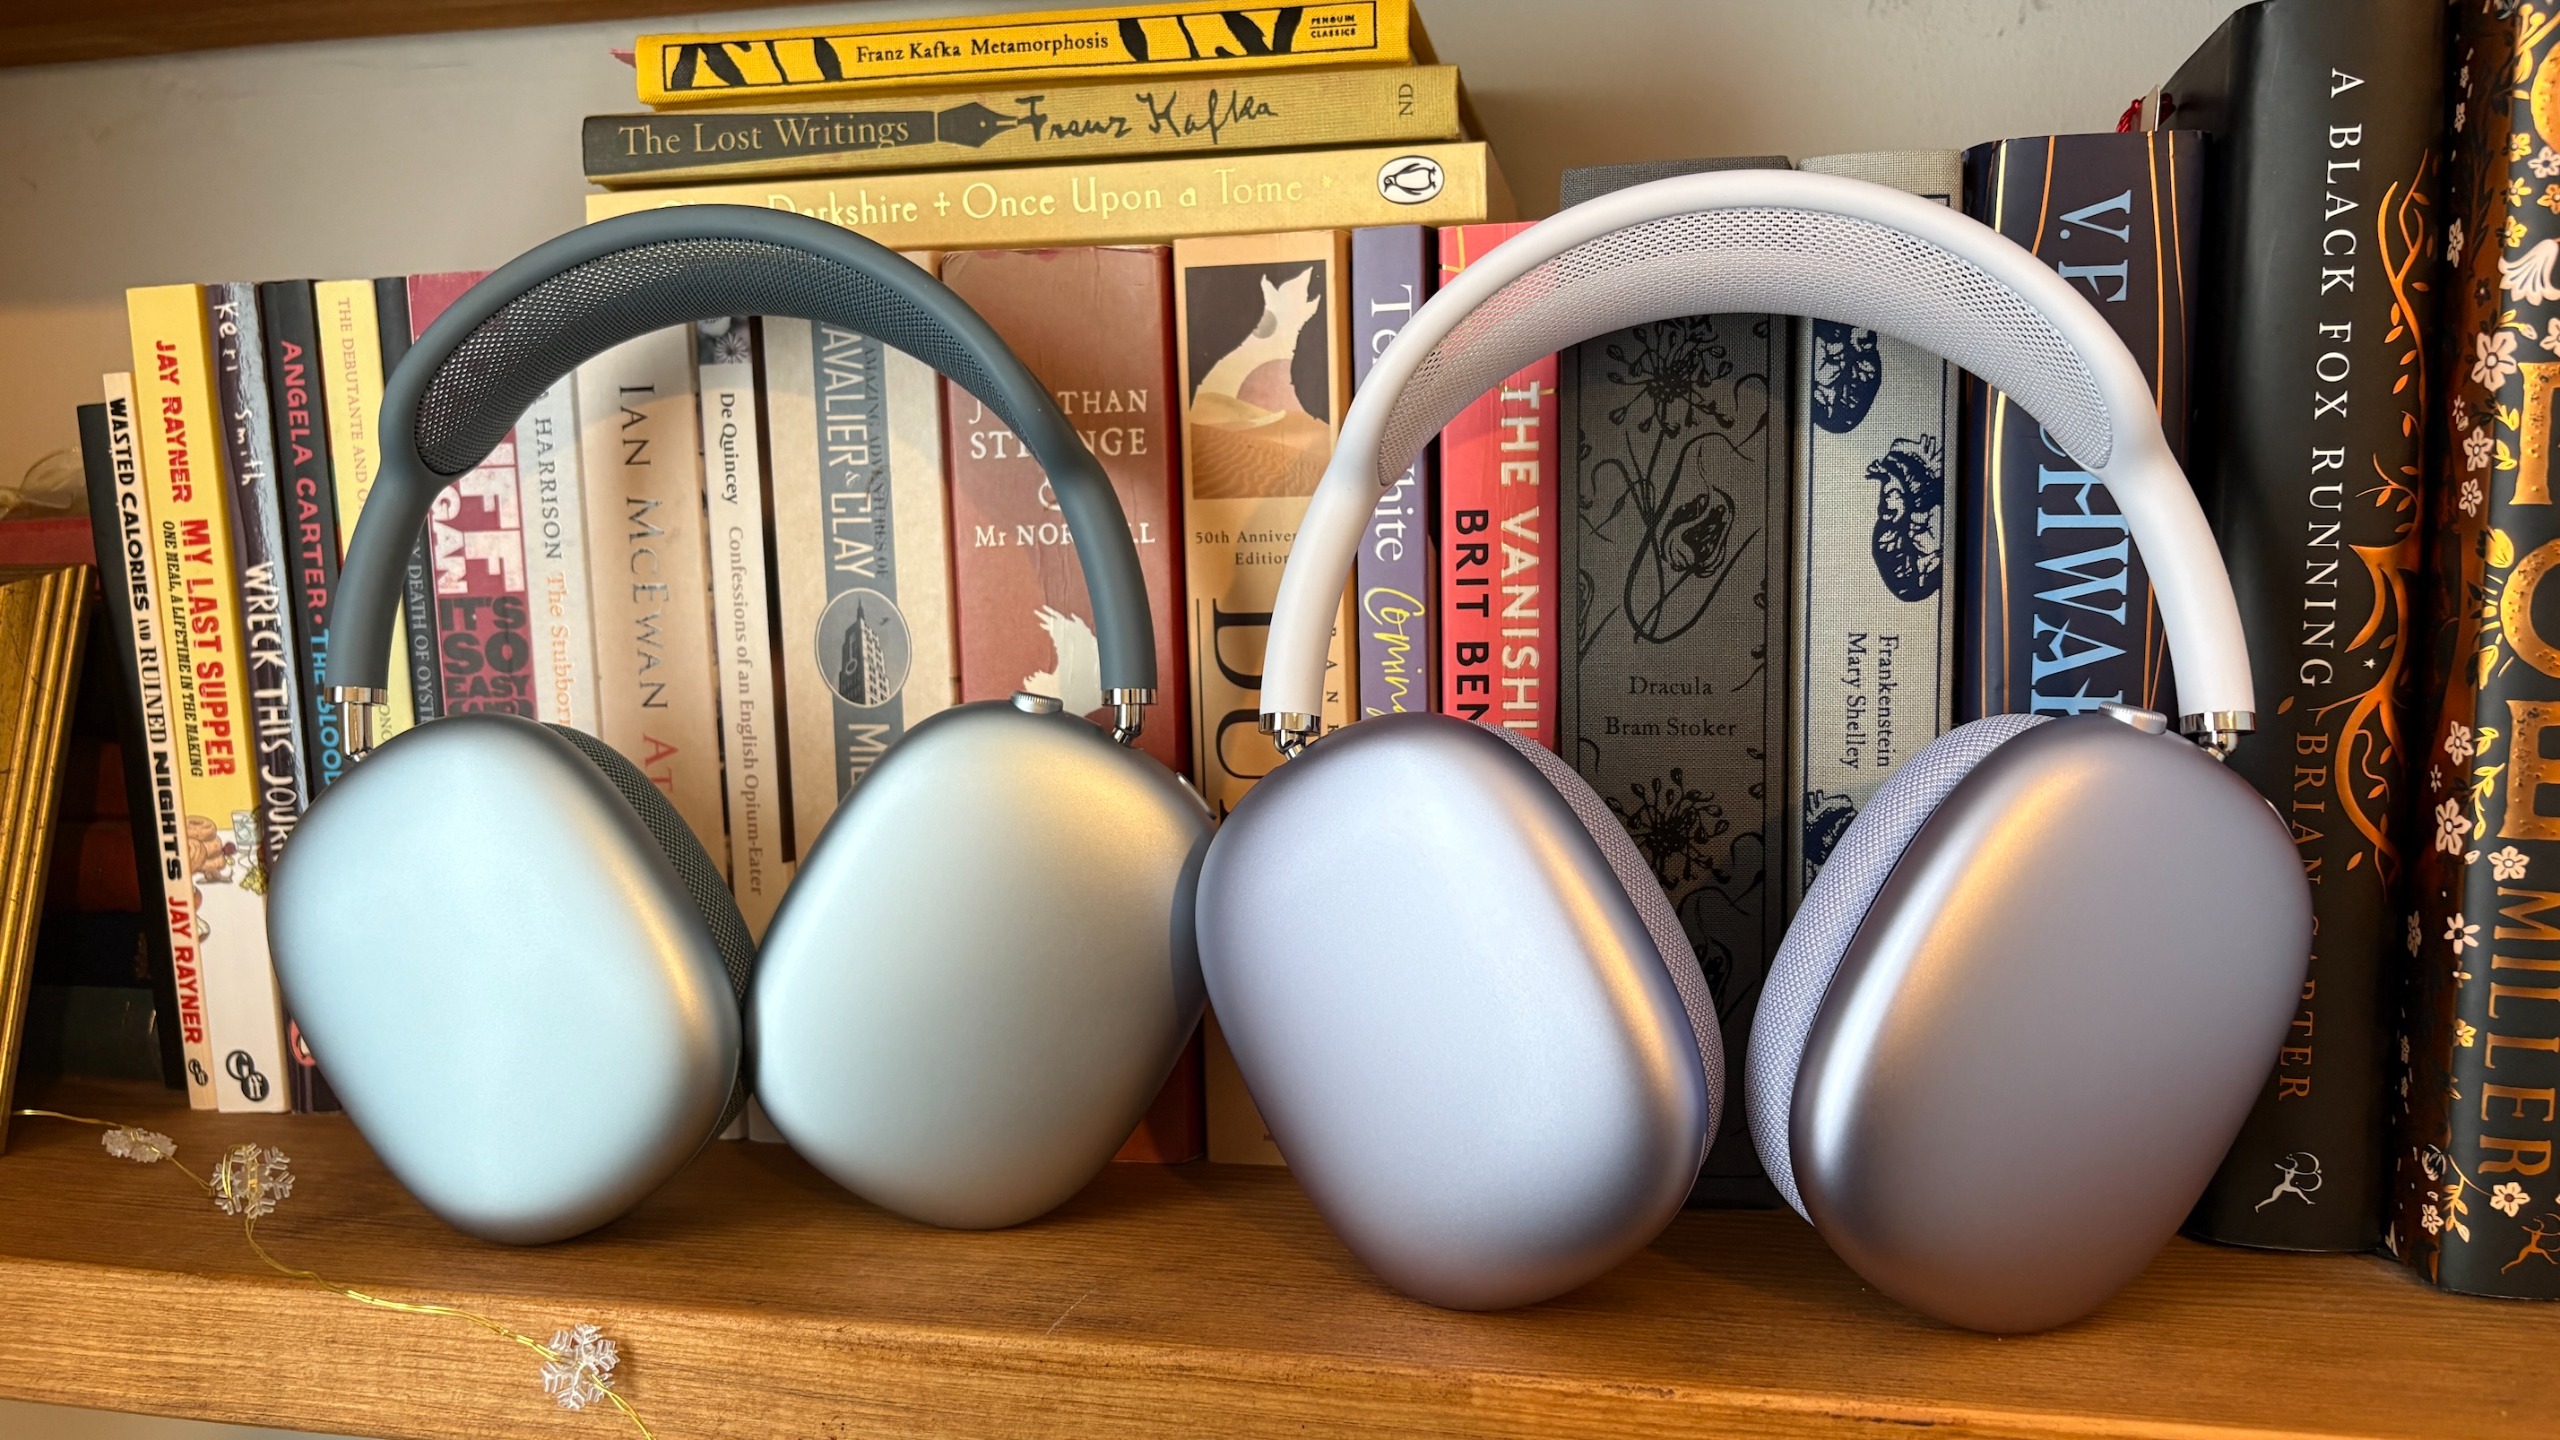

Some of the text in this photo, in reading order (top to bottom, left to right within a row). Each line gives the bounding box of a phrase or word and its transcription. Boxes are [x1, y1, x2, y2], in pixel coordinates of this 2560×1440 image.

[856, 32, 1109, 64] Franz Kafka Metamorphosis
[1310, 28, 1356, 38] CLASSICS
[1311, 14, 1355, 25] PENGUIN
[1136, 88, 1279, 145] Kafka
[1398, 83, 1414, 117] ND
[618, 115, 909, 156] The Lost Writings
[768, 167, 1303, 226] Drkshire Once Upon a Tome
[338, 297, 353, 332] THE
[281, 340, 313, 466] ANGELA
[342, 338, 364, 441] DEBUTANTE
[968, 388, 1149, 425] JTHAN
[2300, 67, 2365, 687] A BLACK FOX RUNNING
[110, 397, 135, 485] WASTED
[619, 384, 655, 469] IAN
[720, 392, 739, 505] De Quincey
[821, 327, 876, 579] AVALIER & CLAY
[969, 427, 1149, 461] STNGE
[353, 445, 368, 484] AND
[535, 417, 562, 560] HARRISON
[163, 521, 178, 549] ONE
[296, 477, 328, 609] CARTER
[975, 522, 1156, 548] Mr NORL
[1195, 529, 1298, 545] 50th Anniver
[1374, 467, 1416, 562] hite
[122, 492, 150, 612] CALORIES
[156, 339, 236, 777] JAY RAYNER MY LAST SUPPER
[1500, 380, 1541, 730] THE VANISHI
[170, 593, 184, 605] A
[408, 565, 427, 630] DEATH
[547, 571, 568, 617] The
[1455, 509, 1490, 721] BRIT BEN
[172, 605, 192, 677] LIFETIME
[311, 628, 330, 685] THE
[414, 635, 430, 662] OF
[443, 631, 530, 676] SO
[139, 644, 167, 744] RUINED
[179, 677, 193, 690] IN
[182, 690, 197, 715] THE
[244, 561, 299, 862] WRECK THIS JOUR
[416, 665, 435, 724] OYSTE
[445, 675, 531, 699] EASY
[728, 526, 764, 896] Confessions of an English Opium-Eater
[1628, 676, 1713, 696] Dracula
[1840, 631, 1868, 770] Mary Shelley
[1876, 633, 1899, 768] Frankenstein
[185, 716, 203, 778] MAKING
[1604, 717, 1738, 737] Bram Stoker
[153, 751, 182, 882] NIGHTS
[2291, 732, 2329, 886] BRIAN
[168, 896, 193, 939] JAY
[174, 946, 203, 1045] RAYNER
[2478, 886, 2560, 1176] MILLER
